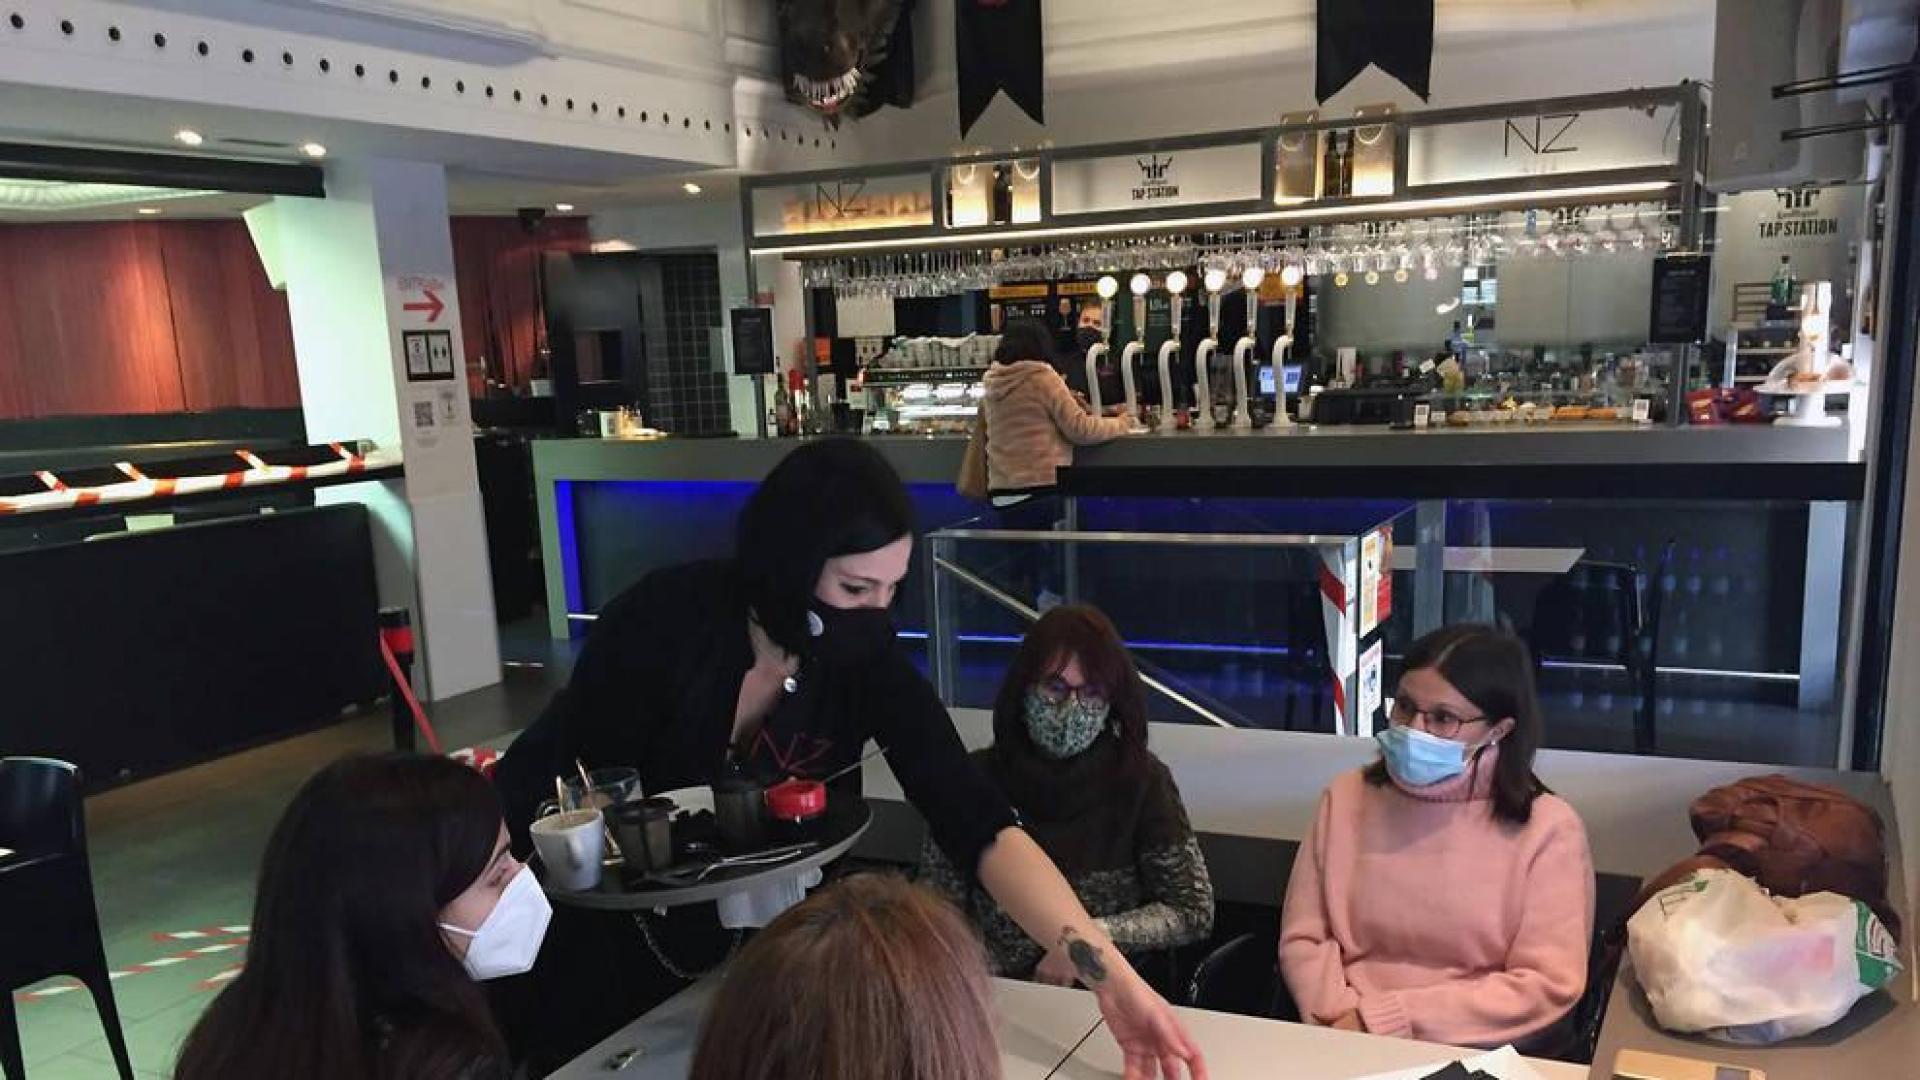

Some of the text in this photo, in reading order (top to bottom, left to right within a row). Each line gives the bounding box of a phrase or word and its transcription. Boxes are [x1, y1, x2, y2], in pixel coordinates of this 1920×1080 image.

[1504, 112, 1579, 158] NZ
[816, 180, 866, 216] NZ
[1131, 184, 1179, 200] TAP STATION
[1760, 218, 1838, 238] TAP STATION
